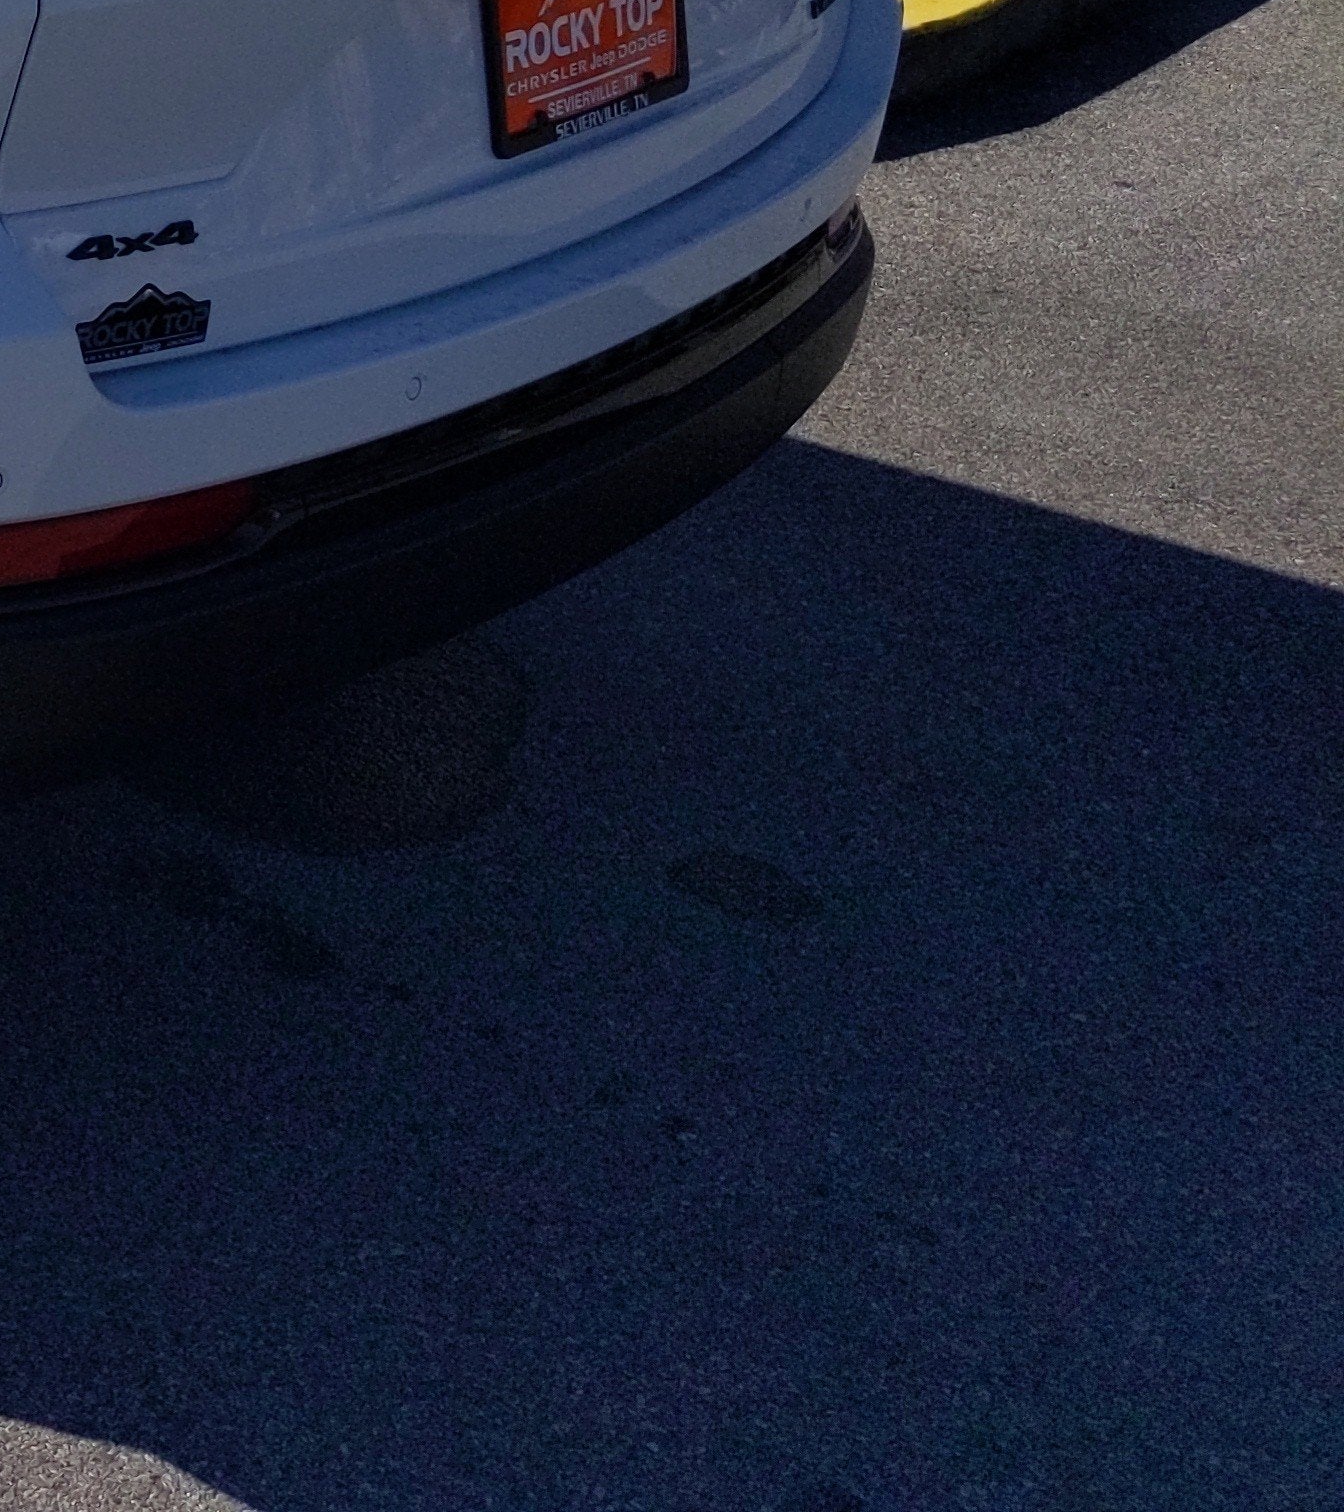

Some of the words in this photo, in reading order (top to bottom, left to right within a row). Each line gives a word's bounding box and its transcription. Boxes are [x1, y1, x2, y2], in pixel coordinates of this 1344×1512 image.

[505, 3, 604, 74] ROCKY
[507, 59, 588, 98] CHRYSLER
[589, 48, 616, 72] Jeep
[618, 28, 668, 59] DODGE
[65, 219, 200, 261] 4x4
